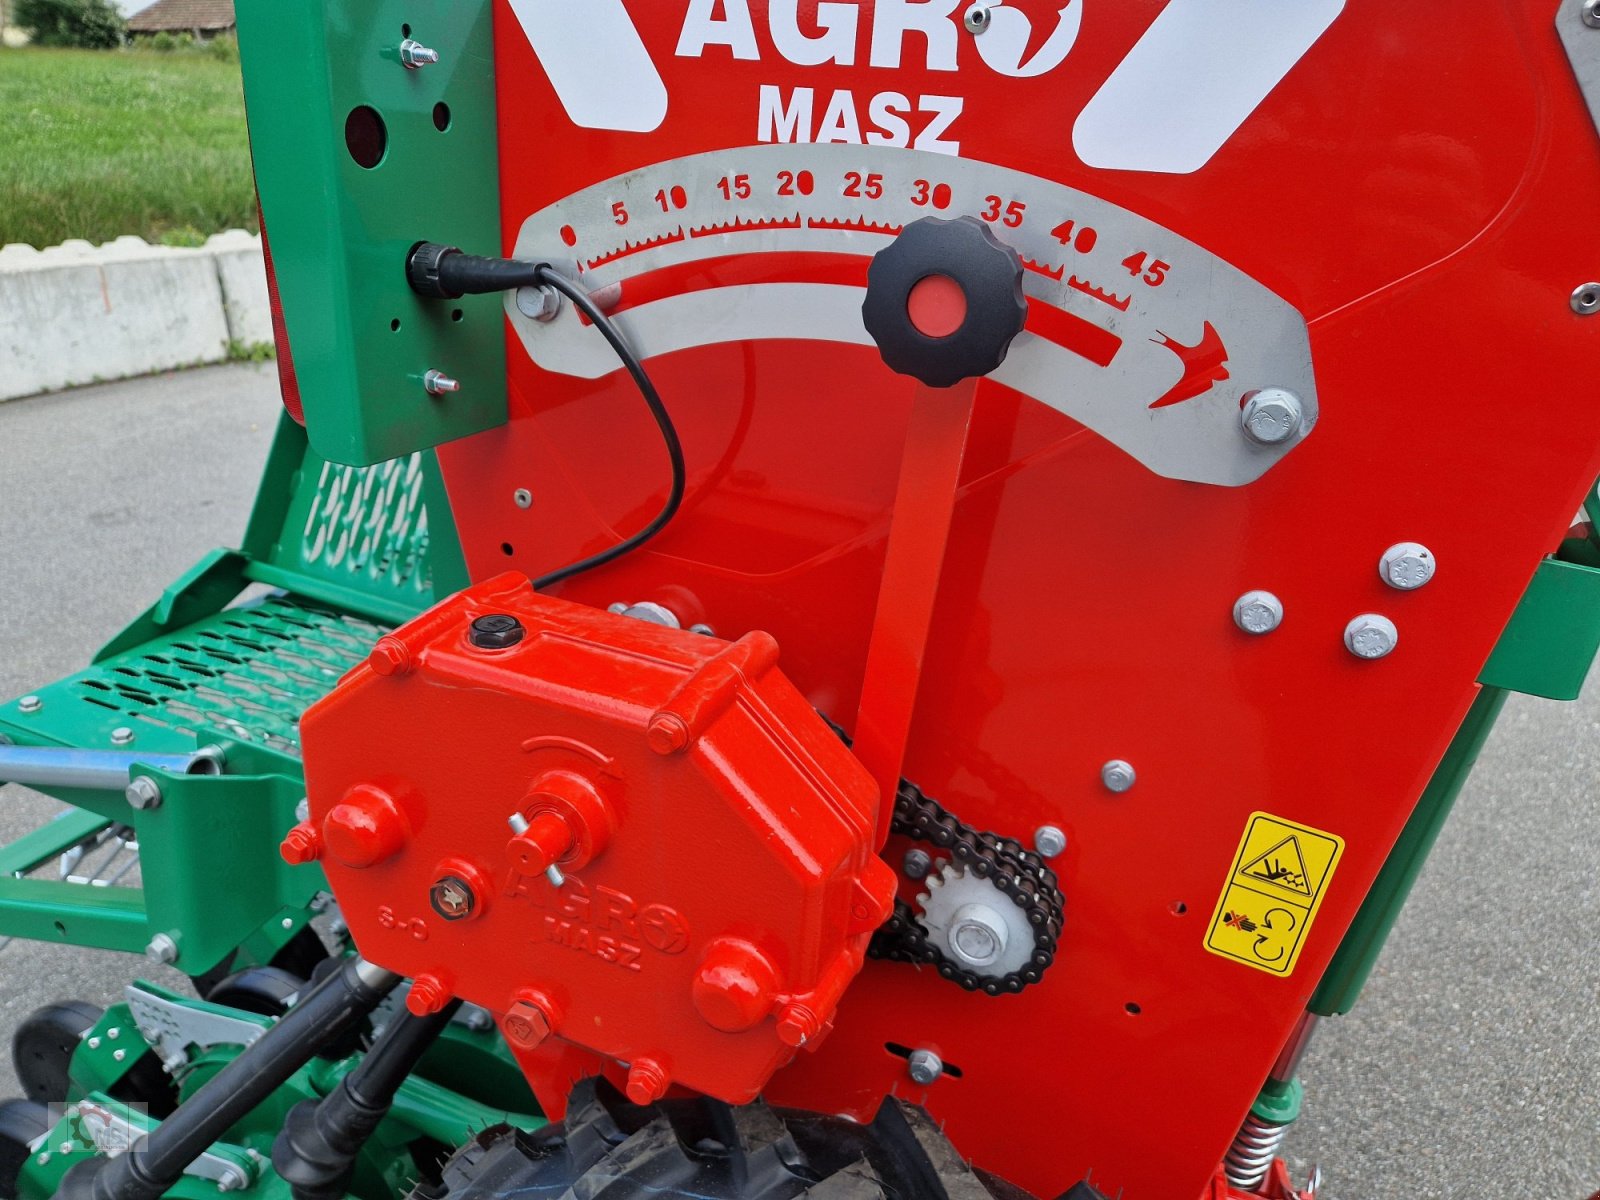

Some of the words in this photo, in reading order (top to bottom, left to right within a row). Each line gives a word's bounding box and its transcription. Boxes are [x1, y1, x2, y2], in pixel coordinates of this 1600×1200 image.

[757, 84, 963, 157] MASZ
[560, 224, 577, 247] 0
[611, 201, 630, 227] 5
[655, 184, 688, 213] 10
[717, 173, 751, 201] 15
[777, 169, 815, 197] 20
[843, 171, 884, 200] 25
[911, 178, 953, 210] 30
[980, 194, 1026, 228] 35
[1050, 219, 1099, 254] 40
[1121, 250, 1171, 288] 45
[544, 916, 642, 973] MASZ
